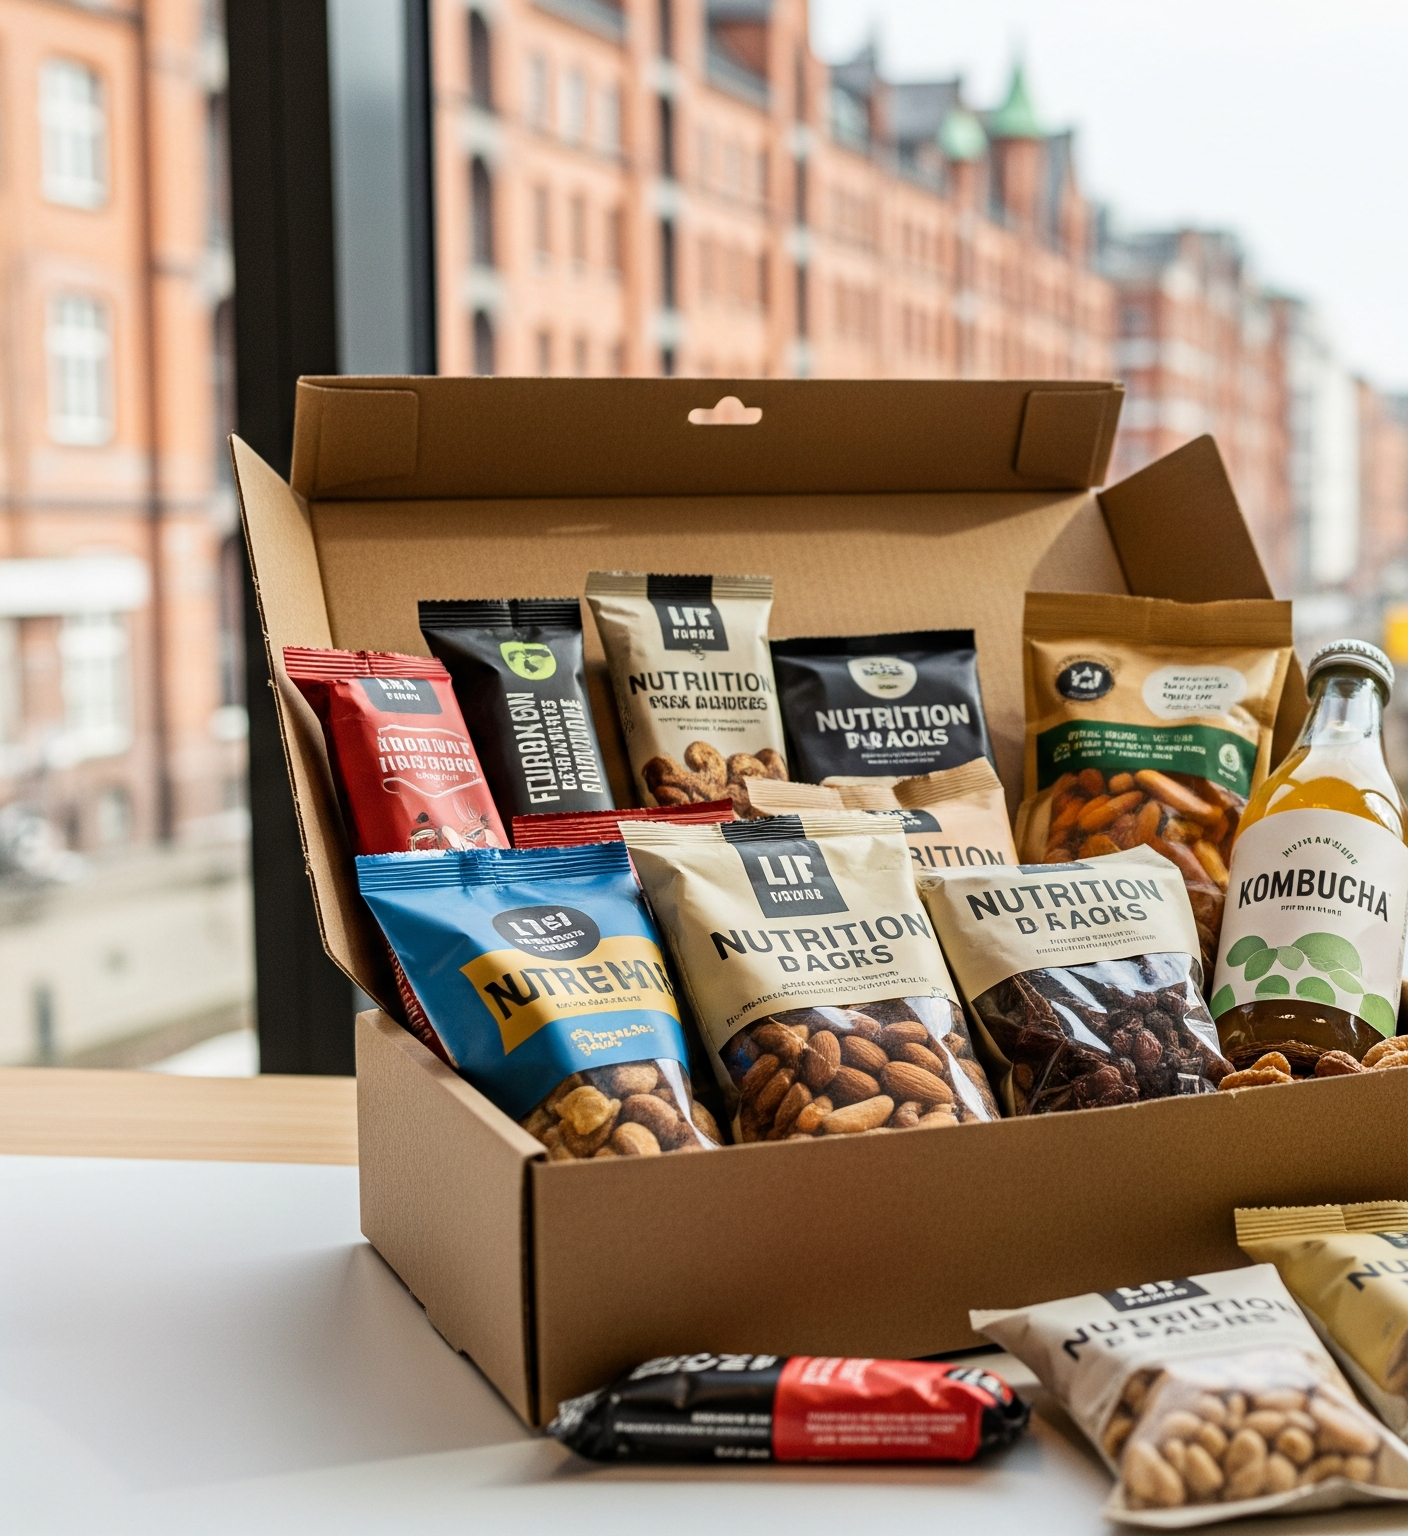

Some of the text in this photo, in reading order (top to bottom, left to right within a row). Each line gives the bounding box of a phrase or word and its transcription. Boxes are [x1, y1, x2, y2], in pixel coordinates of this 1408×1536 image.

[815, 704, 970, 732] NUTRITION
[757, 855, 814, 885] LIF
[966, 879, 1164, 920] NUTRITION
[1238, 869, 1388, 922] KOMBUCHA
[710, 913, 931, 961] NUTRITION
